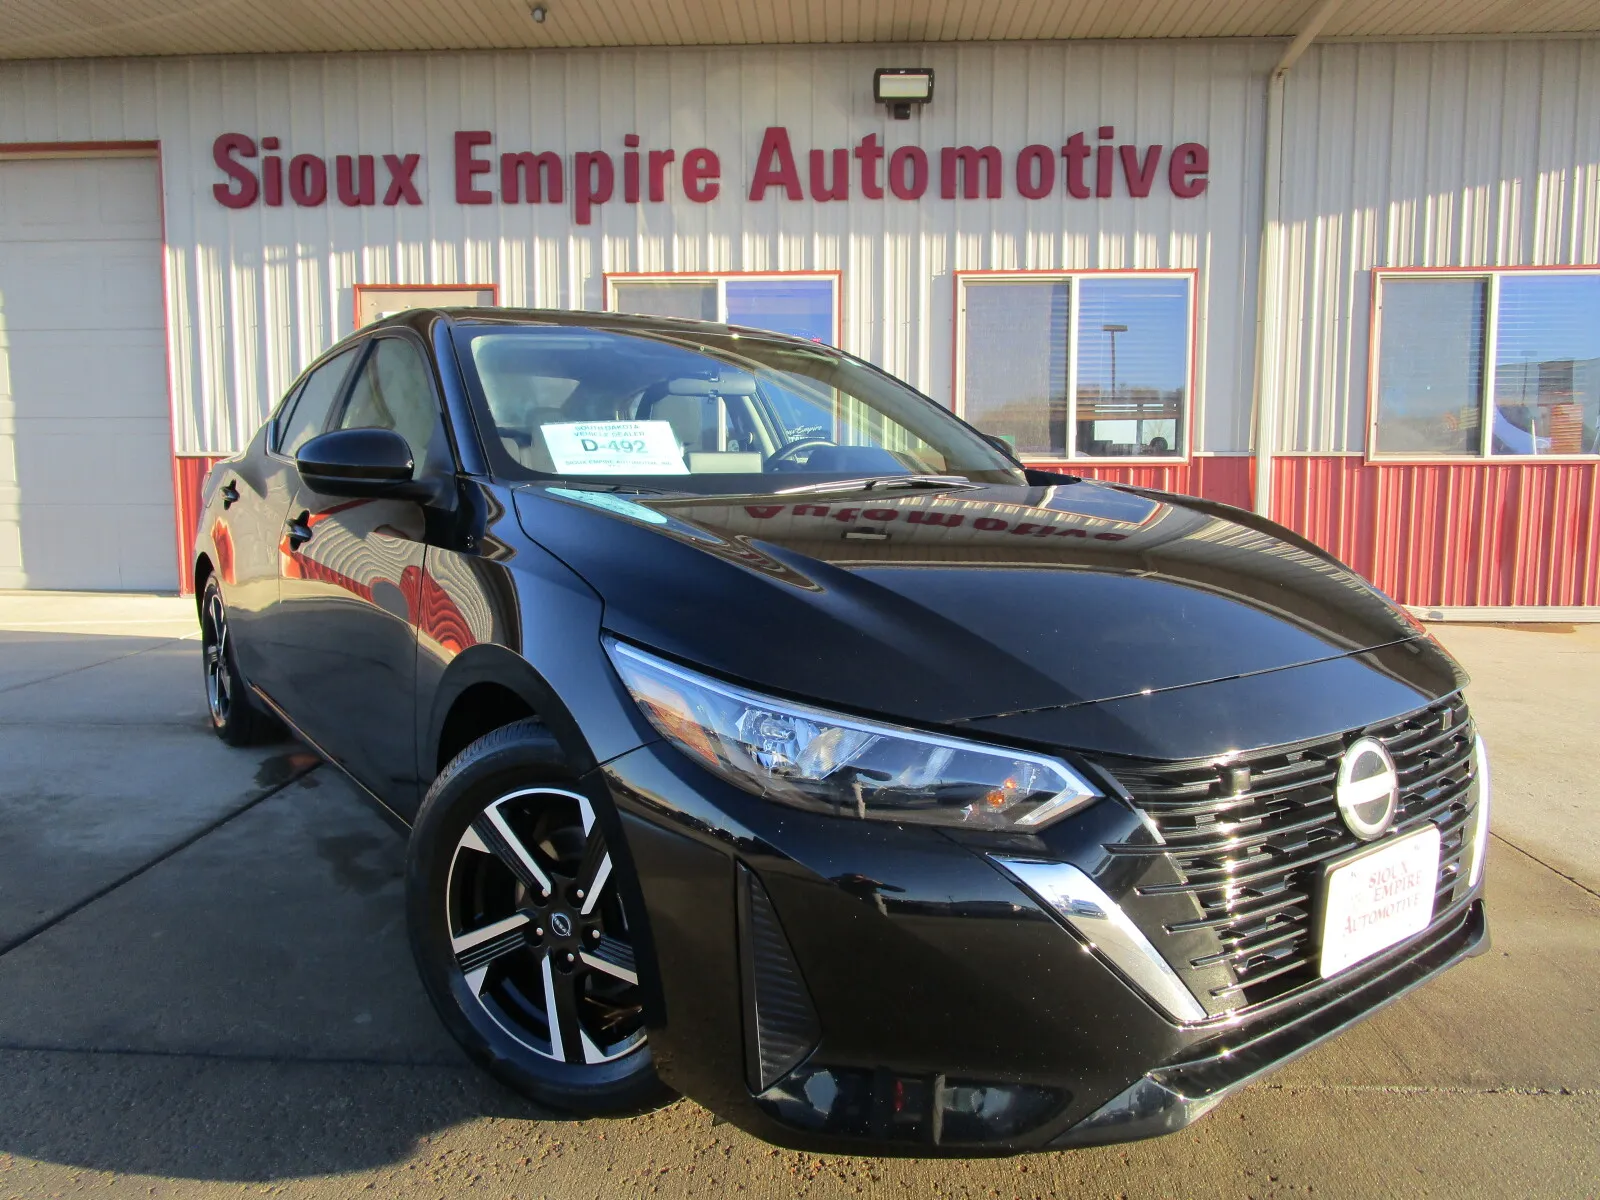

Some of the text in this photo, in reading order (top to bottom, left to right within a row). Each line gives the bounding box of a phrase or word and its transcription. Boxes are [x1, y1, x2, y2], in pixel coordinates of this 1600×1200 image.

[212, 125, 1210, 225] Sioux Empire Automotive
[580, 438, 649, 454] D-492
[1373, 869, 1423, 903] EMPIRE
